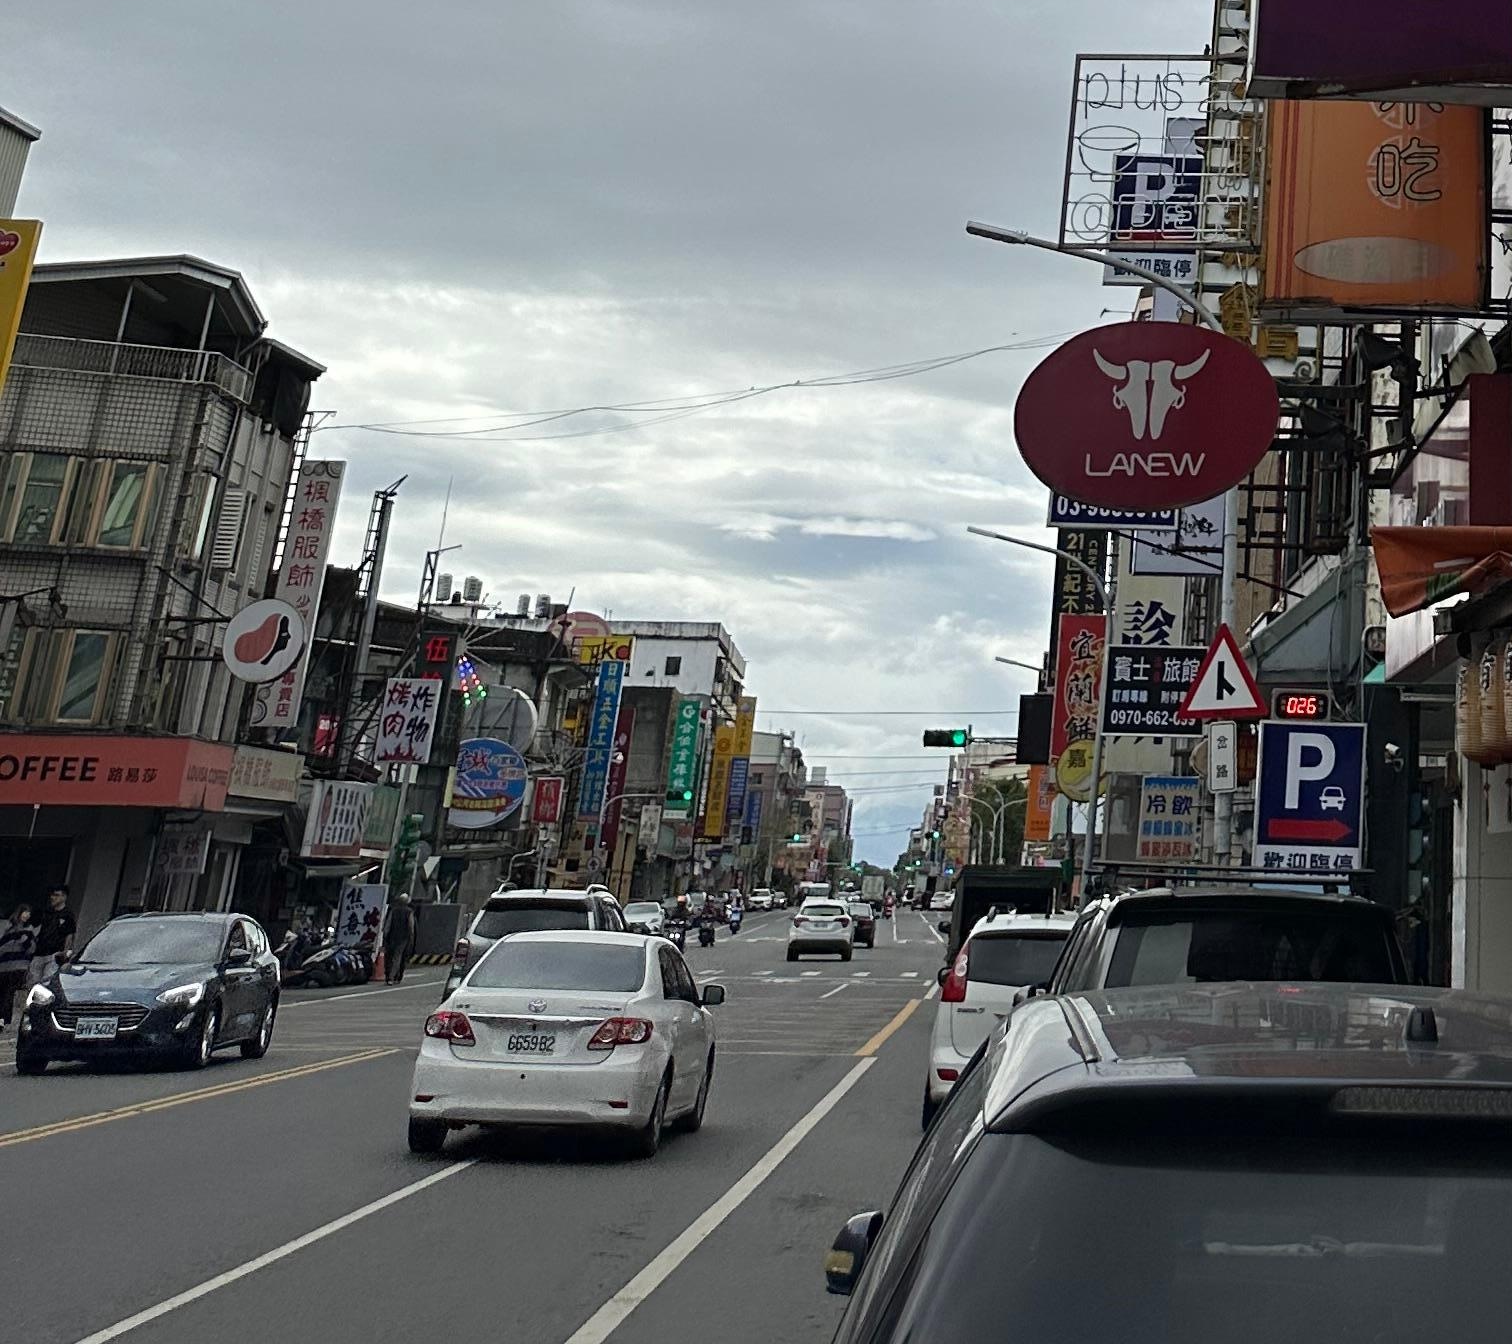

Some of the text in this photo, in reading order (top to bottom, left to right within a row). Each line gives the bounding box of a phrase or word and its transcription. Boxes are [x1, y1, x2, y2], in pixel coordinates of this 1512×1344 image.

[1085, 452, 1206, 477] LANEW
[107, 767, 159, 783] 路易莎
[1285, 732, 1337, 810] P
